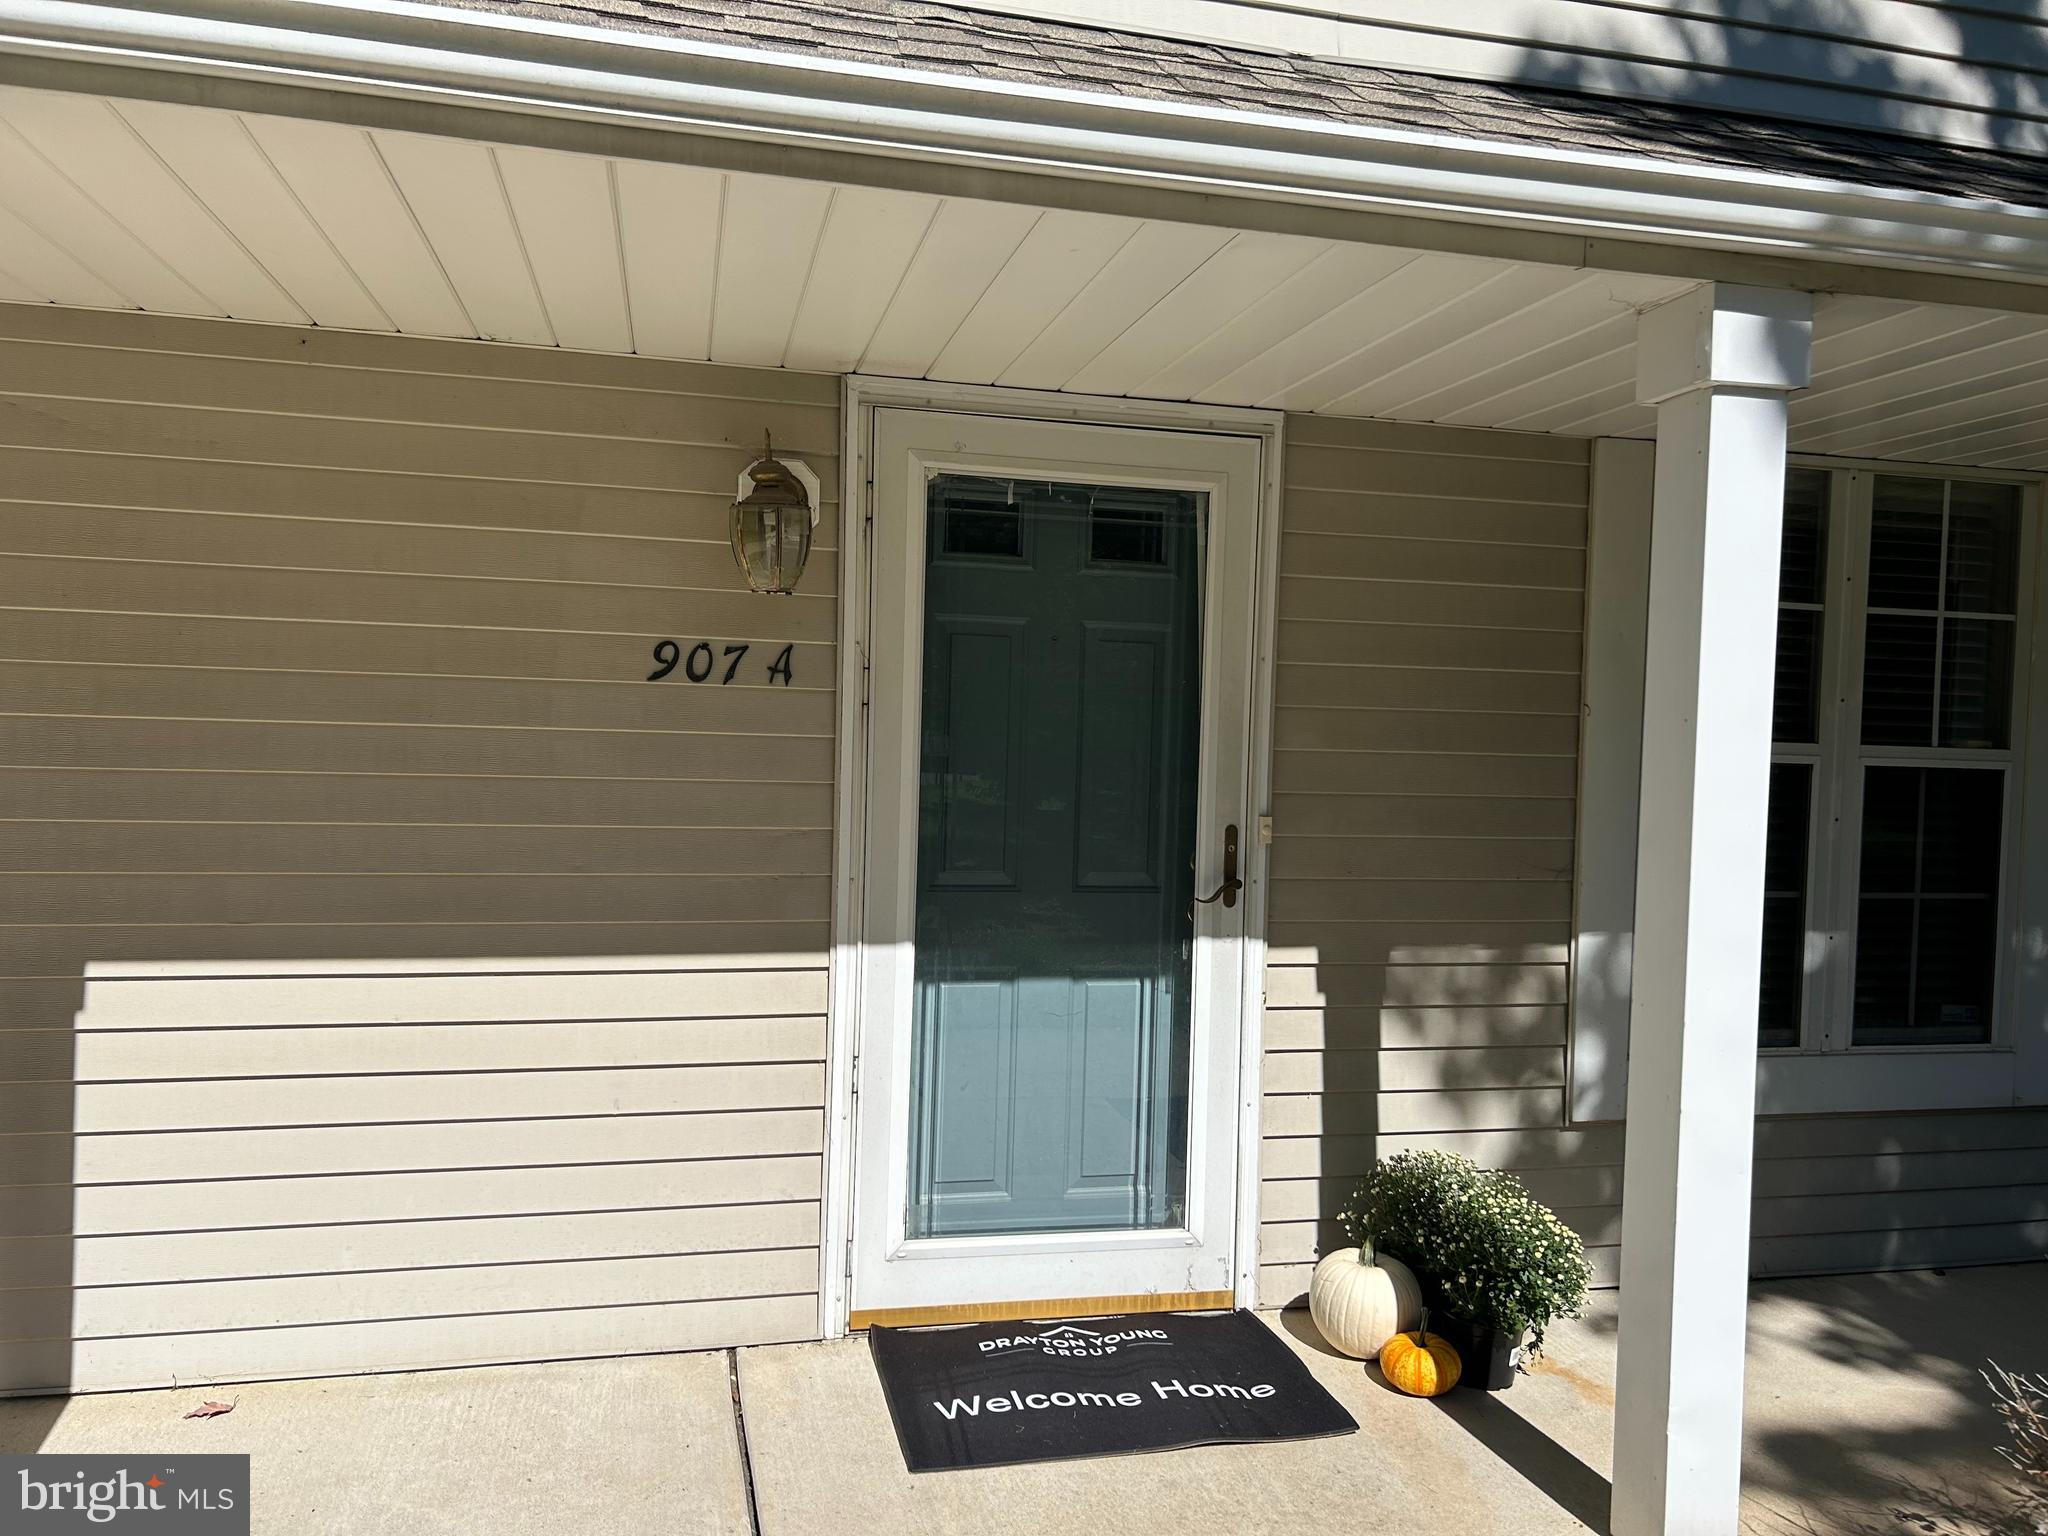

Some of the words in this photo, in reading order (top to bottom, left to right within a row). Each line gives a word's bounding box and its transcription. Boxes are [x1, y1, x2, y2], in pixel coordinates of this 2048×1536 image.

[646, 640, 750, 685] 907
[767, 643, 794, 687] A
[978, 1335, 1086, 1352] DRAYTON
[1089, 1329, 1168, 1346] YOUNG
[1042, 1345, 1118, 1357] GROUP
[933, 1389, 1142, 1420] Welcome
[1150, 1379, 1276, 1400] Home
